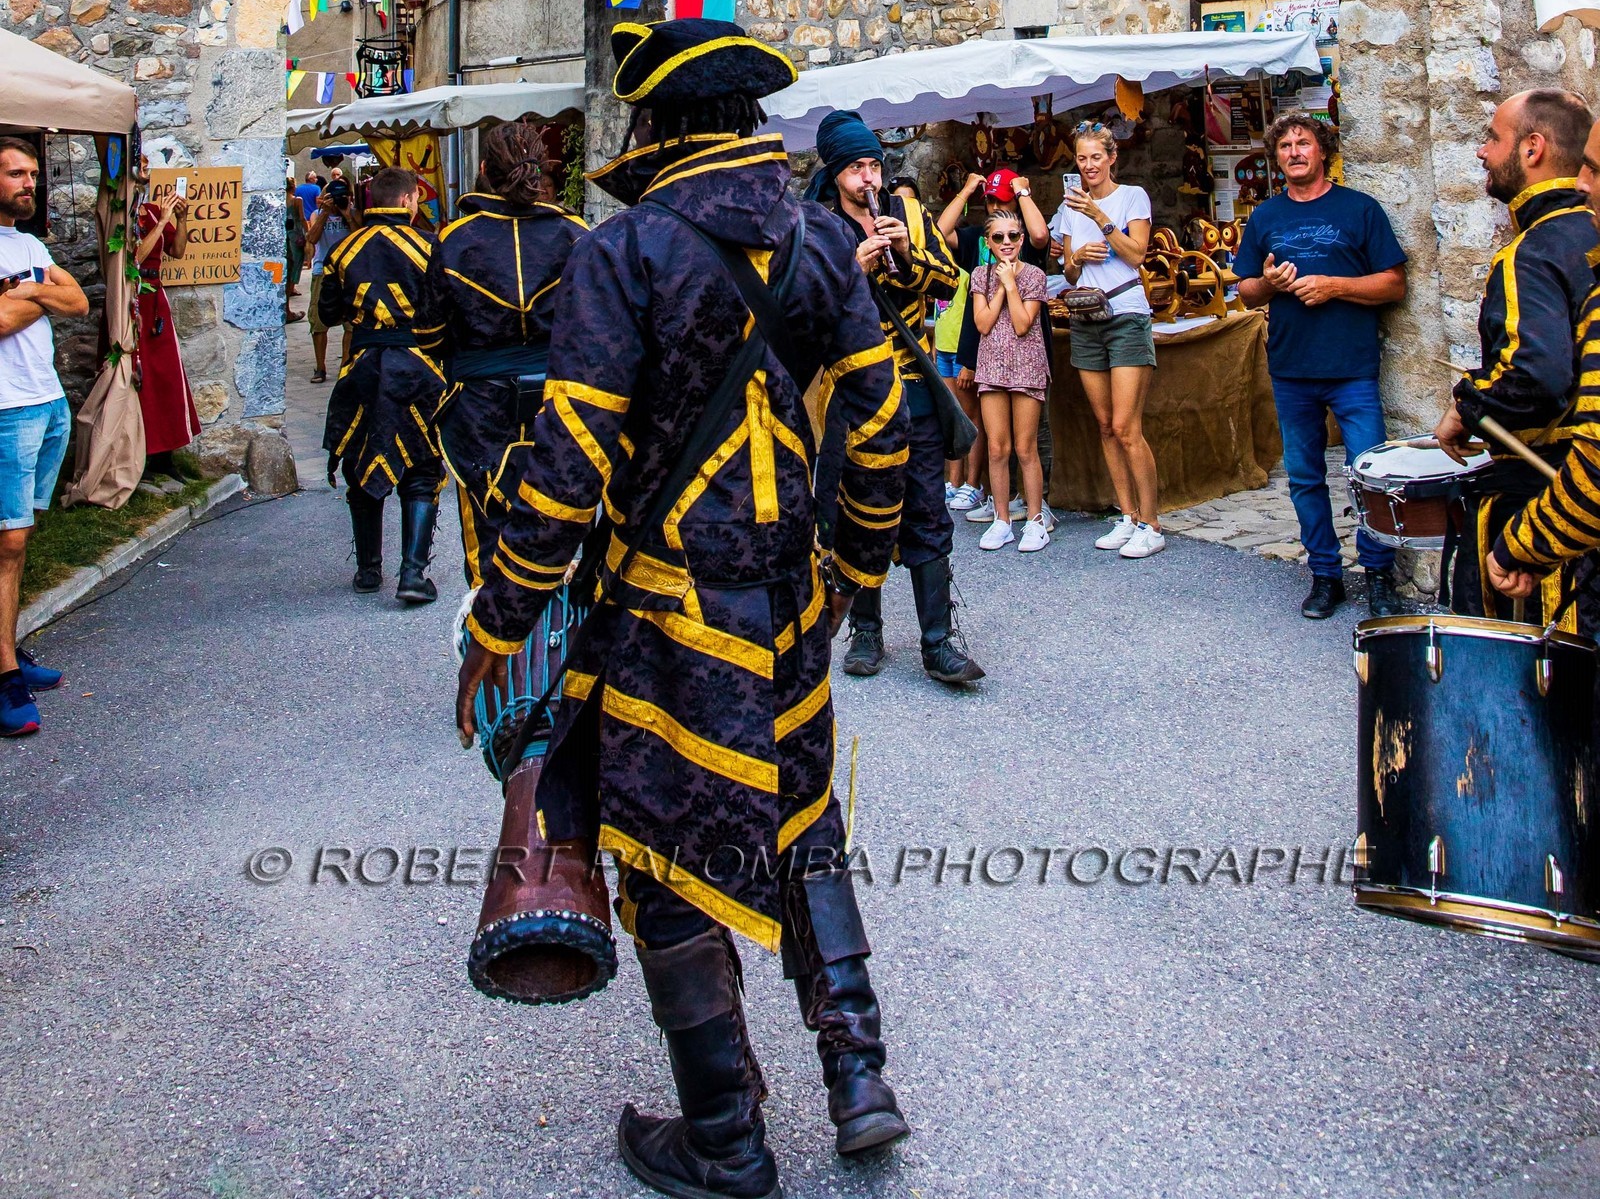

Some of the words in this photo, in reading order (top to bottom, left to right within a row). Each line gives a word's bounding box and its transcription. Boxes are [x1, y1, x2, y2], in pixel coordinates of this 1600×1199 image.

[152, 181, 241, 202] ARSANAT
[186, 202, 231, 221] ECES
[187, 225, 237, 244] QUES
[161, 266, 188, 281] ALYA
[193, 264, 241, 280] BIJOUX
